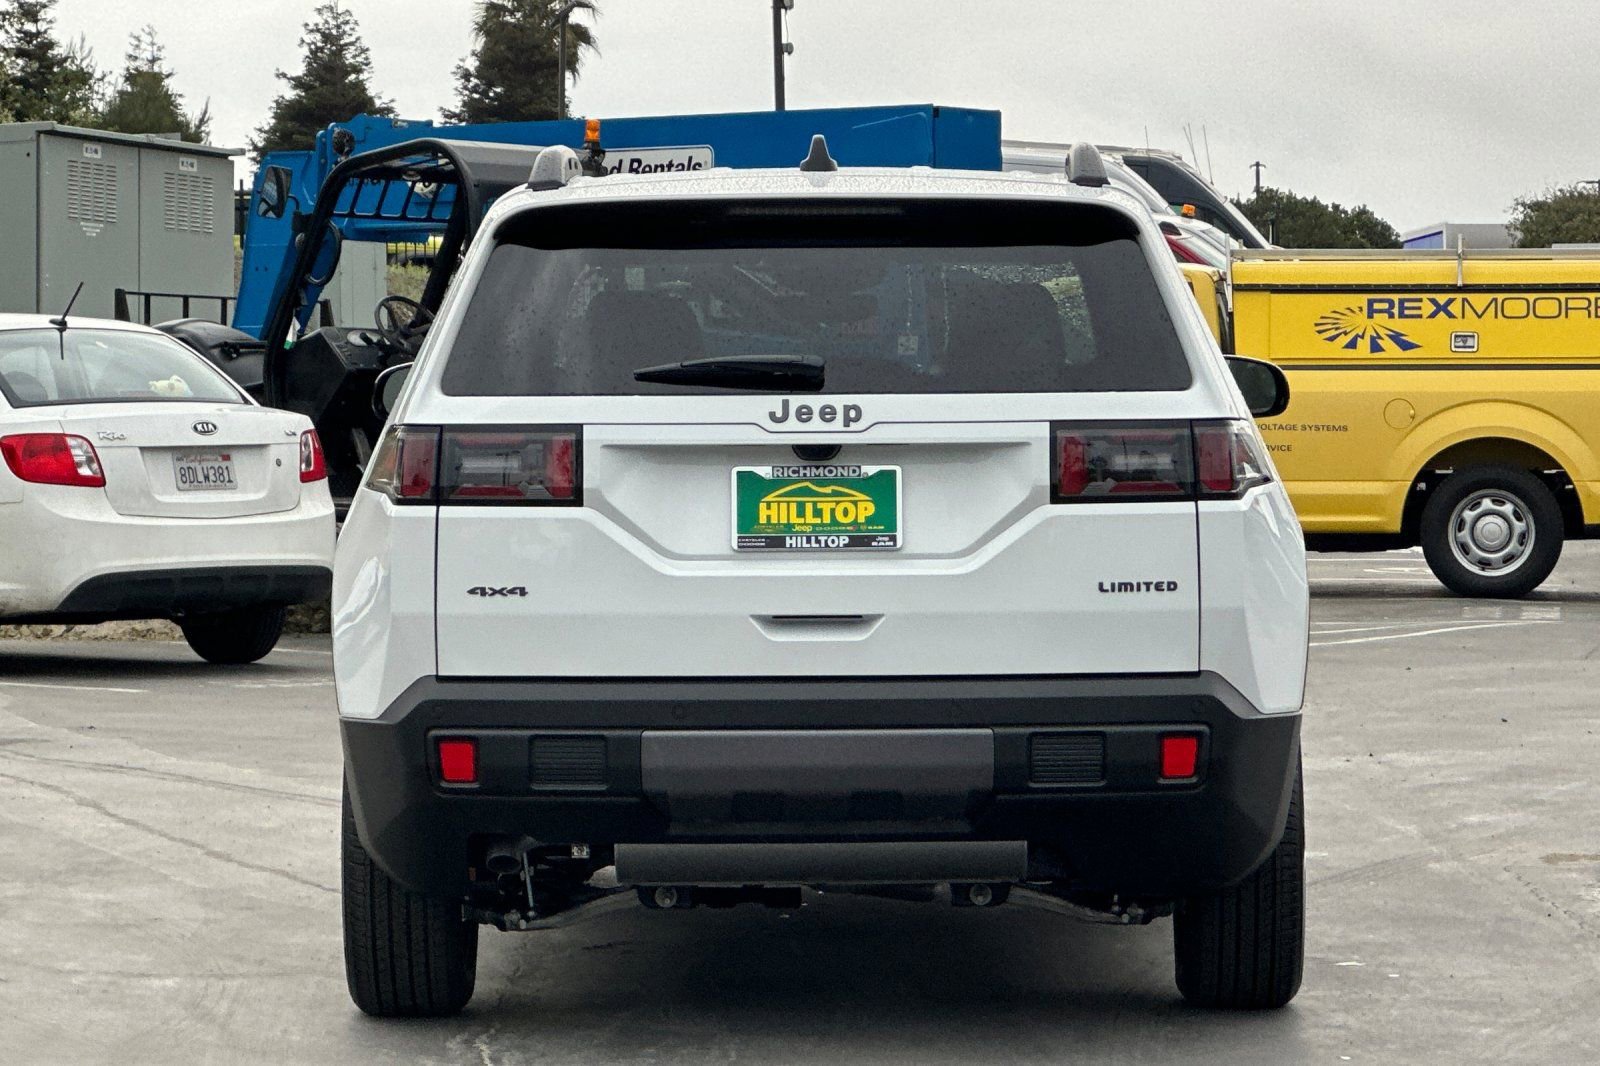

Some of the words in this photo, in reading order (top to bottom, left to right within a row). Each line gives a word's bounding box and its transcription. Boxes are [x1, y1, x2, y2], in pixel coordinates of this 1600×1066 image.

[628, 155, 703, 174] Rentals
[768, 399, 863, 428] Jeep
[195, 423, 215, 432] KIA
[1257, 423, 1298, 432] OLTAGE
[1300, 424, 1348, 432] SYSTEMS
[1265, 444, 1293, 452] RVICE
[179, 466, 233, 484] 8DLW381
[772, 466, 860, 478] RICHMOND
[759, 501, 875, 523] HILLTOP
[792, 524, 813, 533] Jeep
[785, 535, 850, 548] HILLTOP
[1098, 581, 1178, 593] LIMITED
